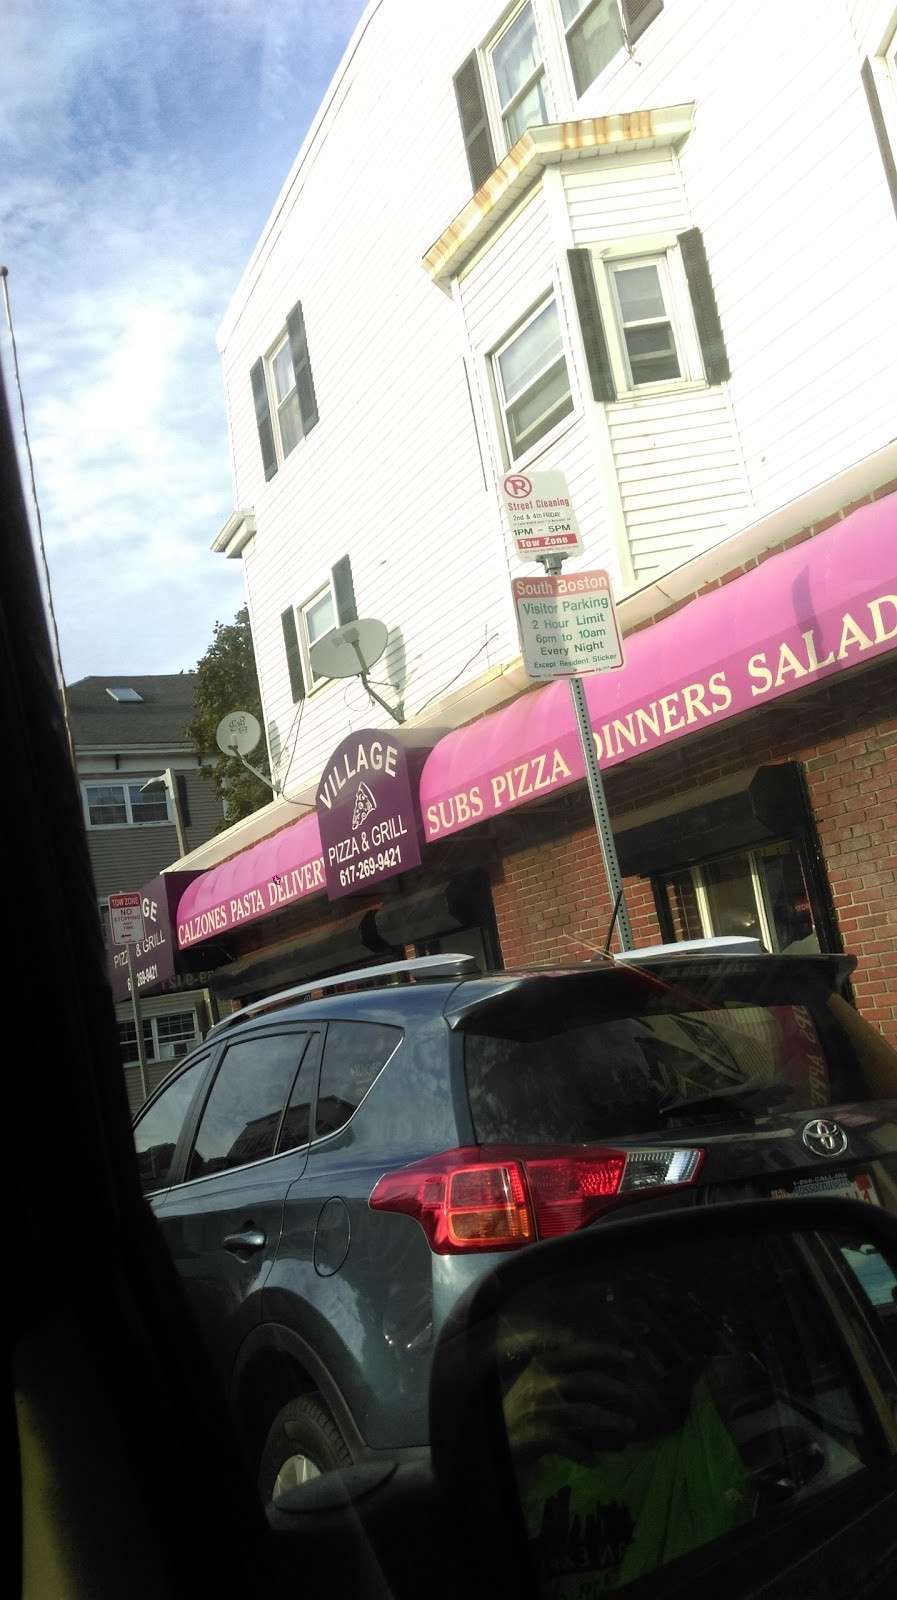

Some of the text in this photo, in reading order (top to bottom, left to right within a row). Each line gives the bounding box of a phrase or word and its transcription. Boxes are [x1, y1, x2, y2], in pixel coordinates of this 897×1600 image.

[508, 498, 570, 512] Street Cleaning
[513, 528, 533, 536] 1PM
[548, 524, 571, 533] 5PM
[520, 537, 568, 548] Tow Zone
[516, 576, 607, 596] South Boston
[523, 597, 609, 615] Visitor Parking
[532, 613, 605, 630] 2 Hour Limit
[536, 628, 606, 644] 6pm to 10am
[540, 640, 604, 656] Every Night
[534, 654, 617, 668] Except Resident Sticker
[230, 718, 245, 728] dish
[319, 741, 398, 810] VILLAGE
[427, 785, 484, 835] SUBS
[490, 749, 573, 809] PIZZA
[328, 814, 408, 867] PIZZA & GRILL
[340, 844, 402, 887] 617-269-9421
[112, 896, 139, 907] TOW ZONE
[178, 904, 228, 946] CALZONES
[230, 888, 266, 922] PASTA
[114, 929, 166, 968] PIZZ & GRILL
[793, 1178, 852, 1196] Massachusetts
